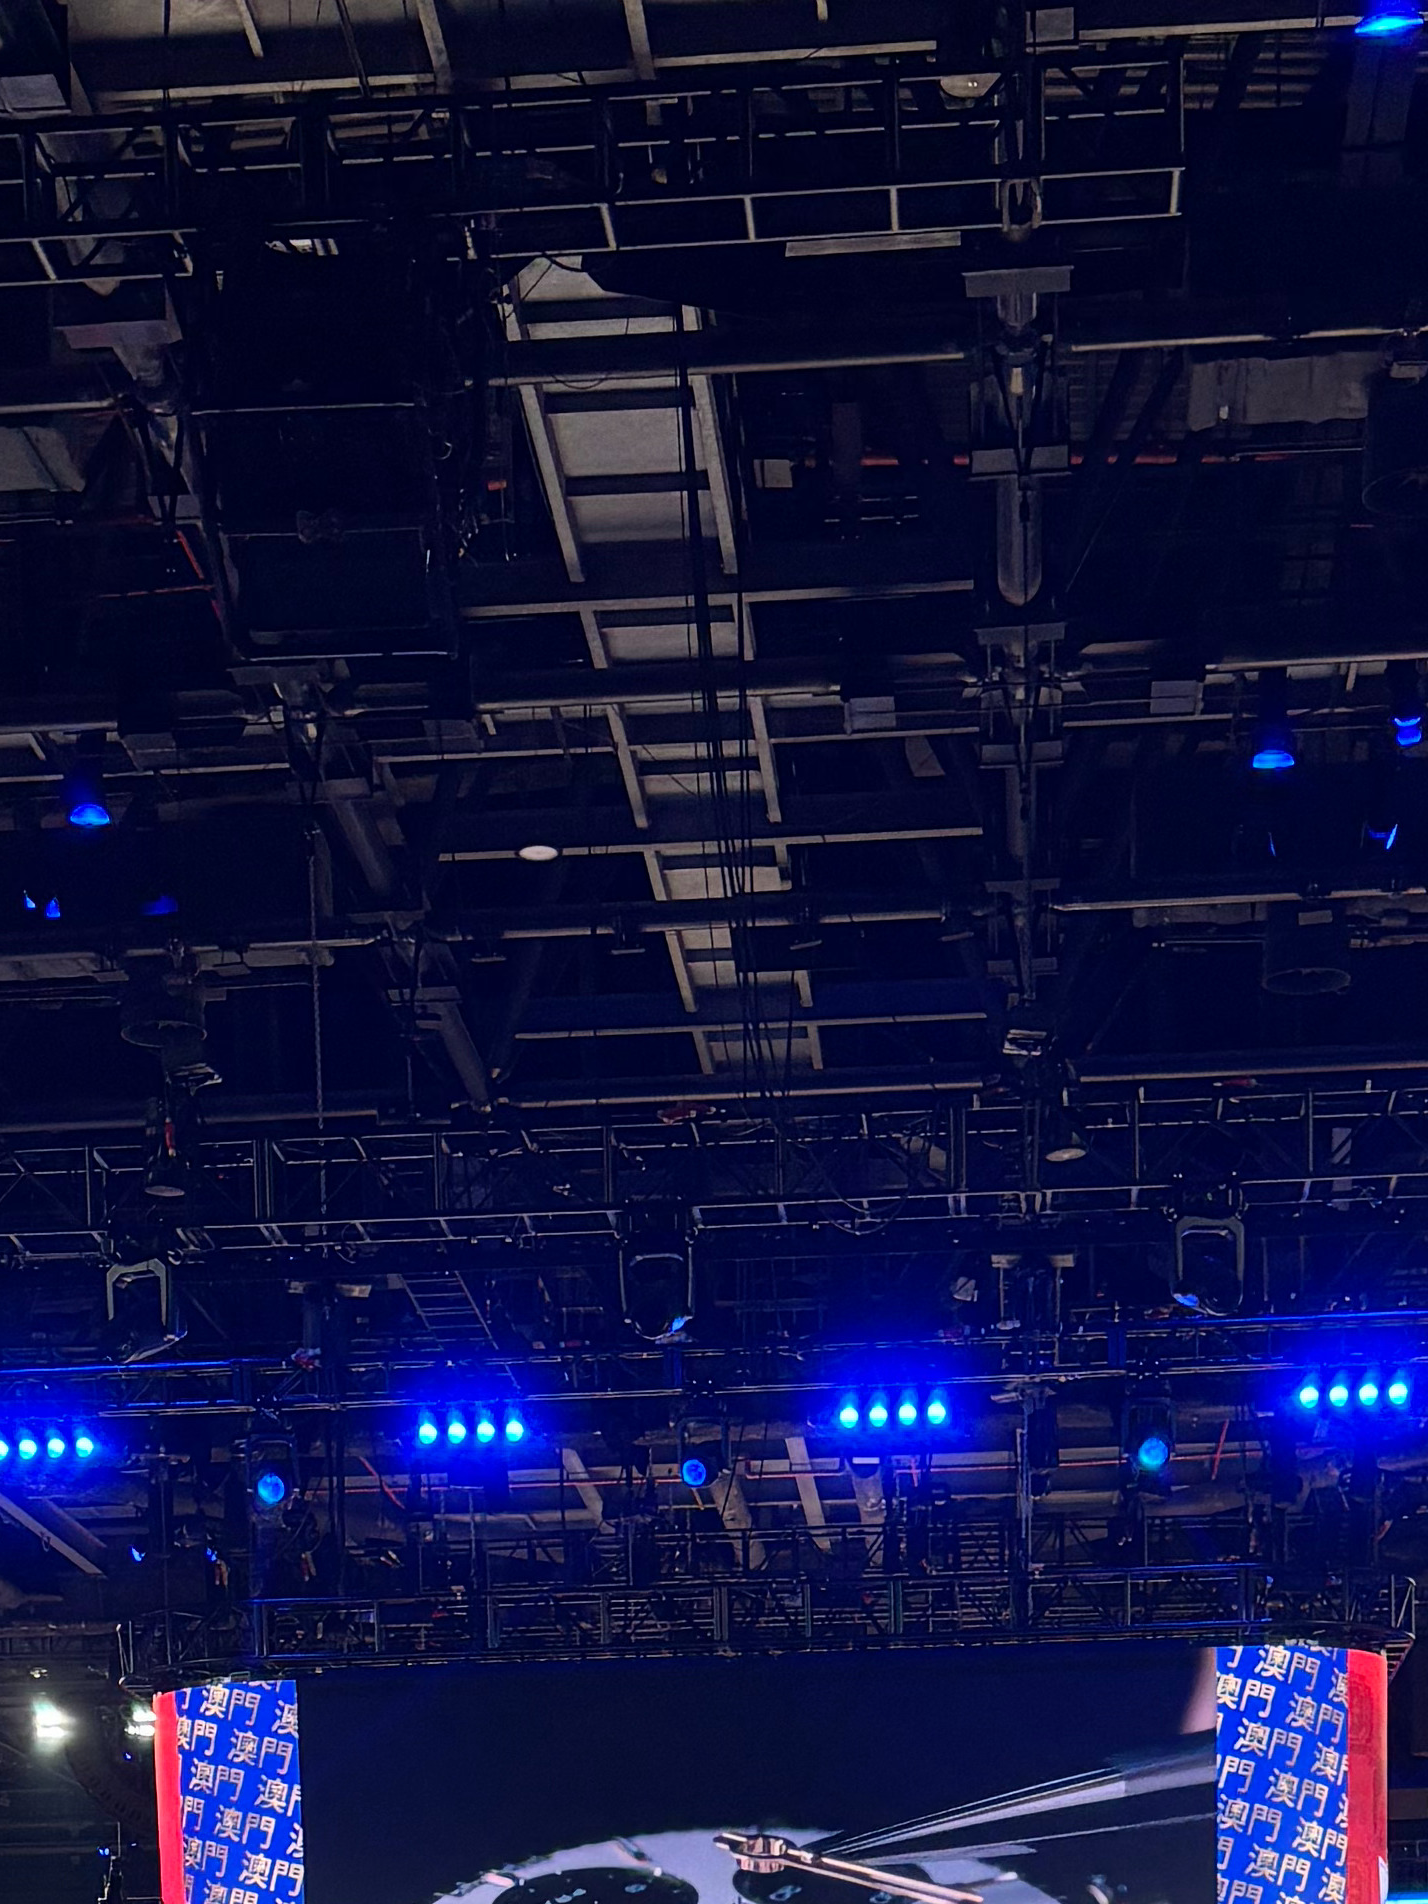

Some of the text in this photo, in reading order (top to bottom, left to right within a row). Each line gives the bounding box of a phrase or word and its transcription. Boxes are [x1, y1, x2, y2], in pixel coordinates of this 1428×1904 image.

[1254, 1647, 1319, 1690] 澳門
[200, 1688, 261, 1726] 澳門
[1286, 1693, 1344, 1744] 澳門
[228, 1728, 293, 1775] 澳門
[1234, 1717, 1302, 1770] 澳門
[189, 1757, 244, 1802] 澳門
[1265, 1768, 1329, 1817] 澳門
[214, 1804, 275, 1849] 澳門
[1217, 1794, 1282, 1842] 澳門
[1292, 1817, 1347, 1866] 澳門
[183, 1833, 228, 1878] 澳門
[239, 1850, 303, 1897] 澳門
[1245, 1843, 1310, 1892] 澳門
